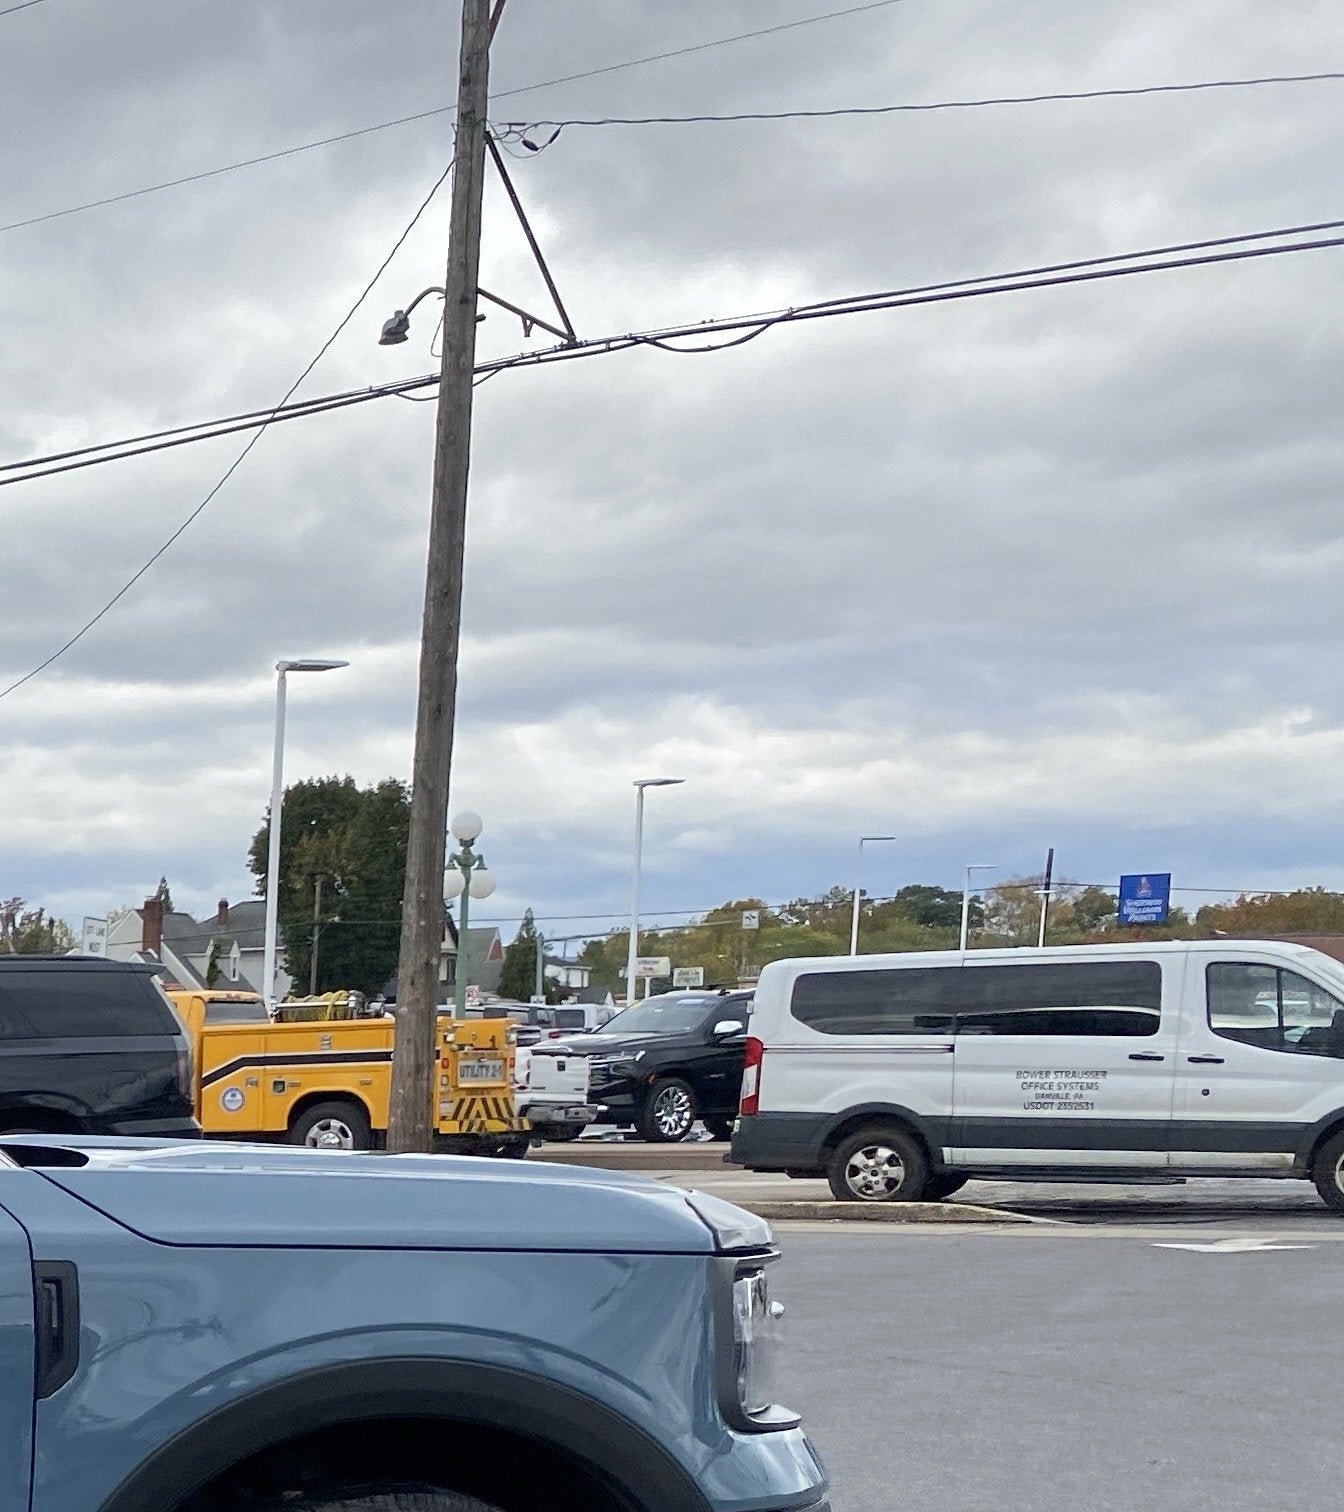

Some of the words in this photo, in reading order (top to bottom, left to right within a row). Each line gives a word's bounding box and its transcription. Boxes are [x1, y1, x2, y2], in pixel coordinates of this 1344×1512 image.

[1015, 1070, 1051, 1080] BOWER
[1021, 1081, 1054, 1091] OFFICE
[1056, 1081, 1099, 1091] SYSTEMS
[1023, 1101, 1054, 1111] USDOT
